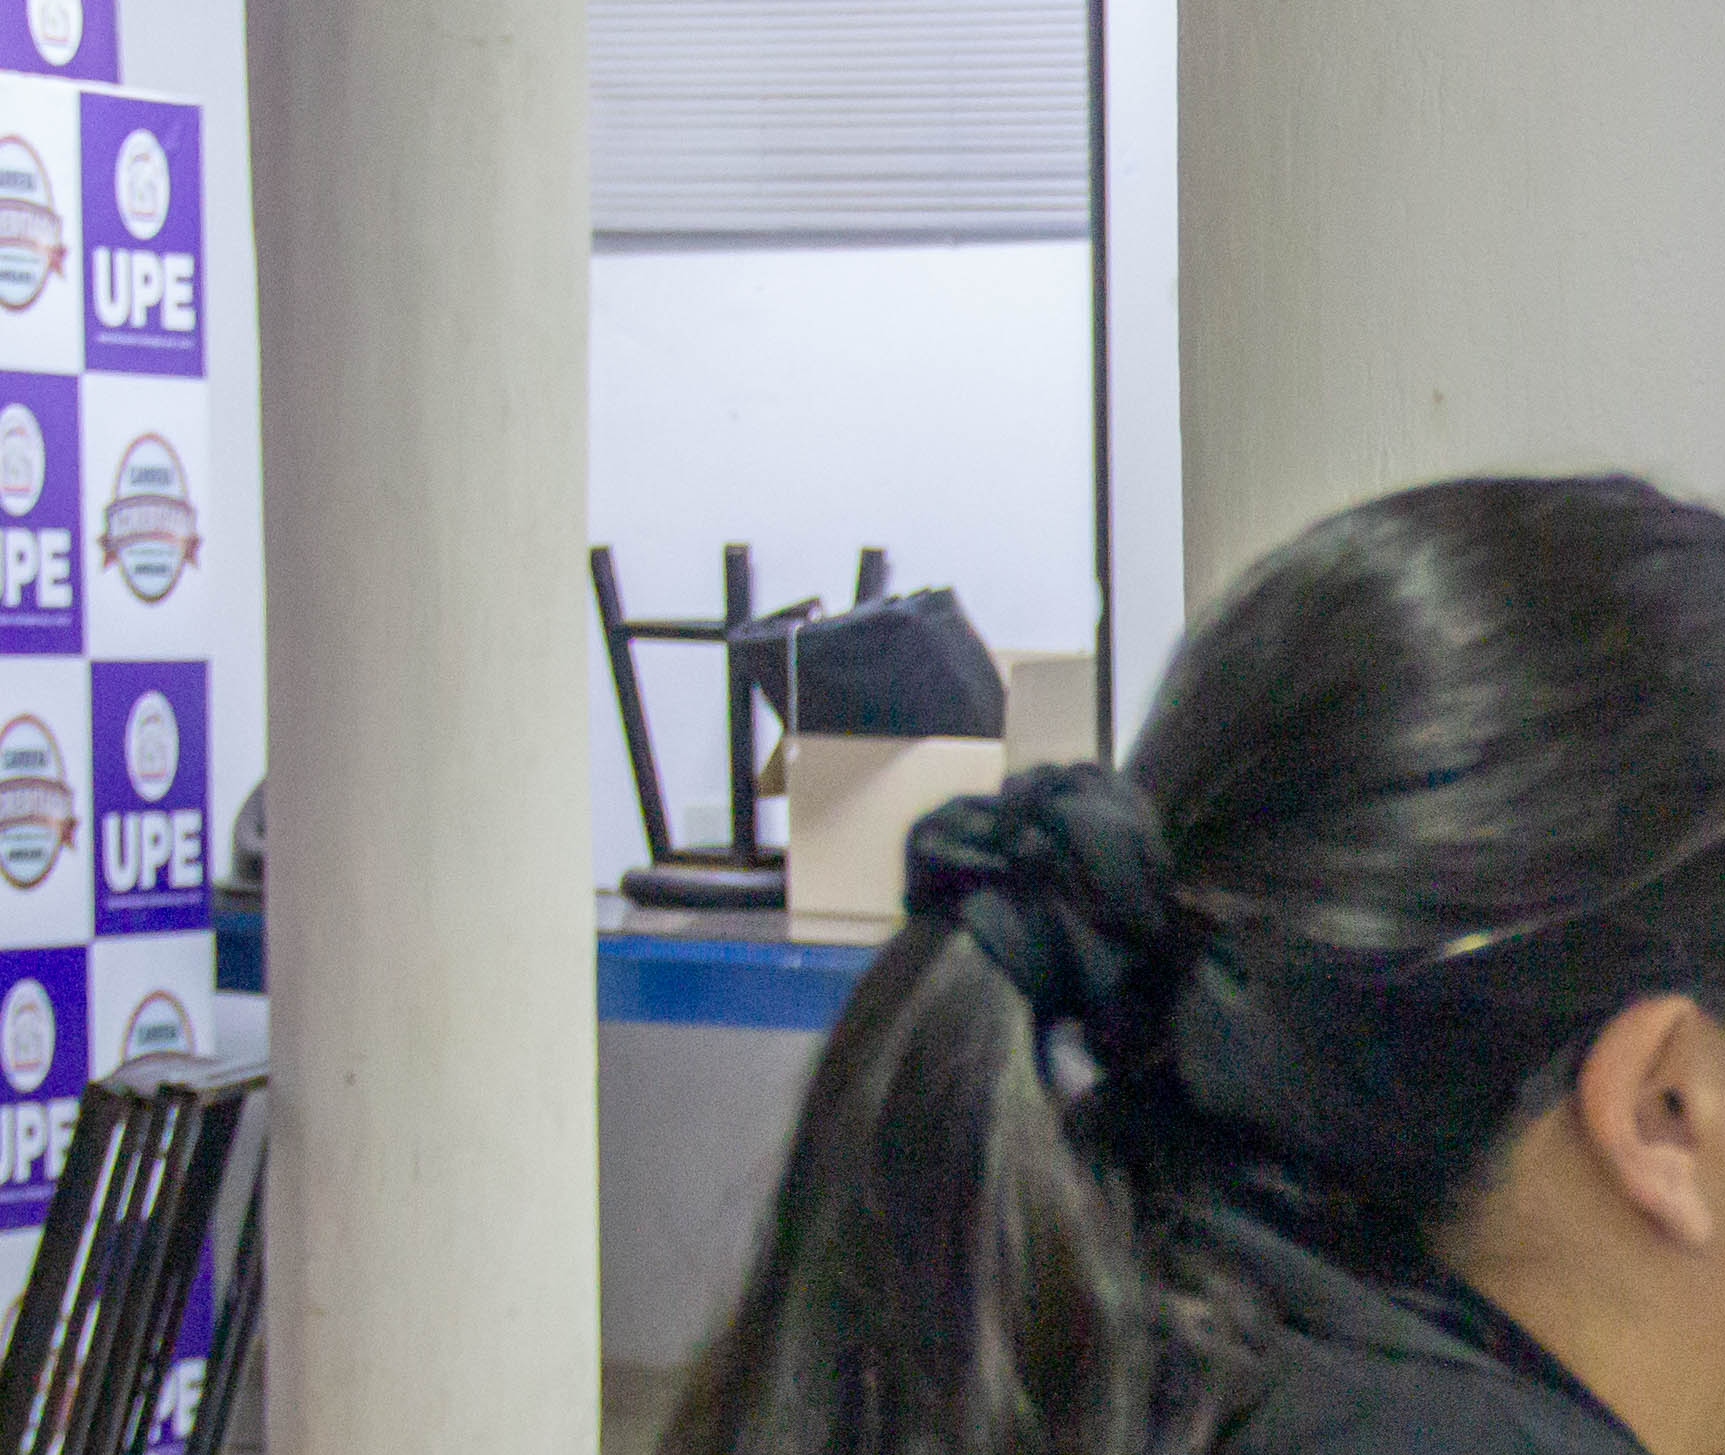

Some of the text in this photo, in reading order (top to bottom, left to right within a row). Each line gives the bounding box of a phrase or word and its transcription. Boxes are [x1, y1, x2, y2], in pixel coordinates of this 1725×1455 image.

[92, 246, 196, 331] UPE
[0, 527, 73, 608] PE
[102, 809, 203, 894] UPE
